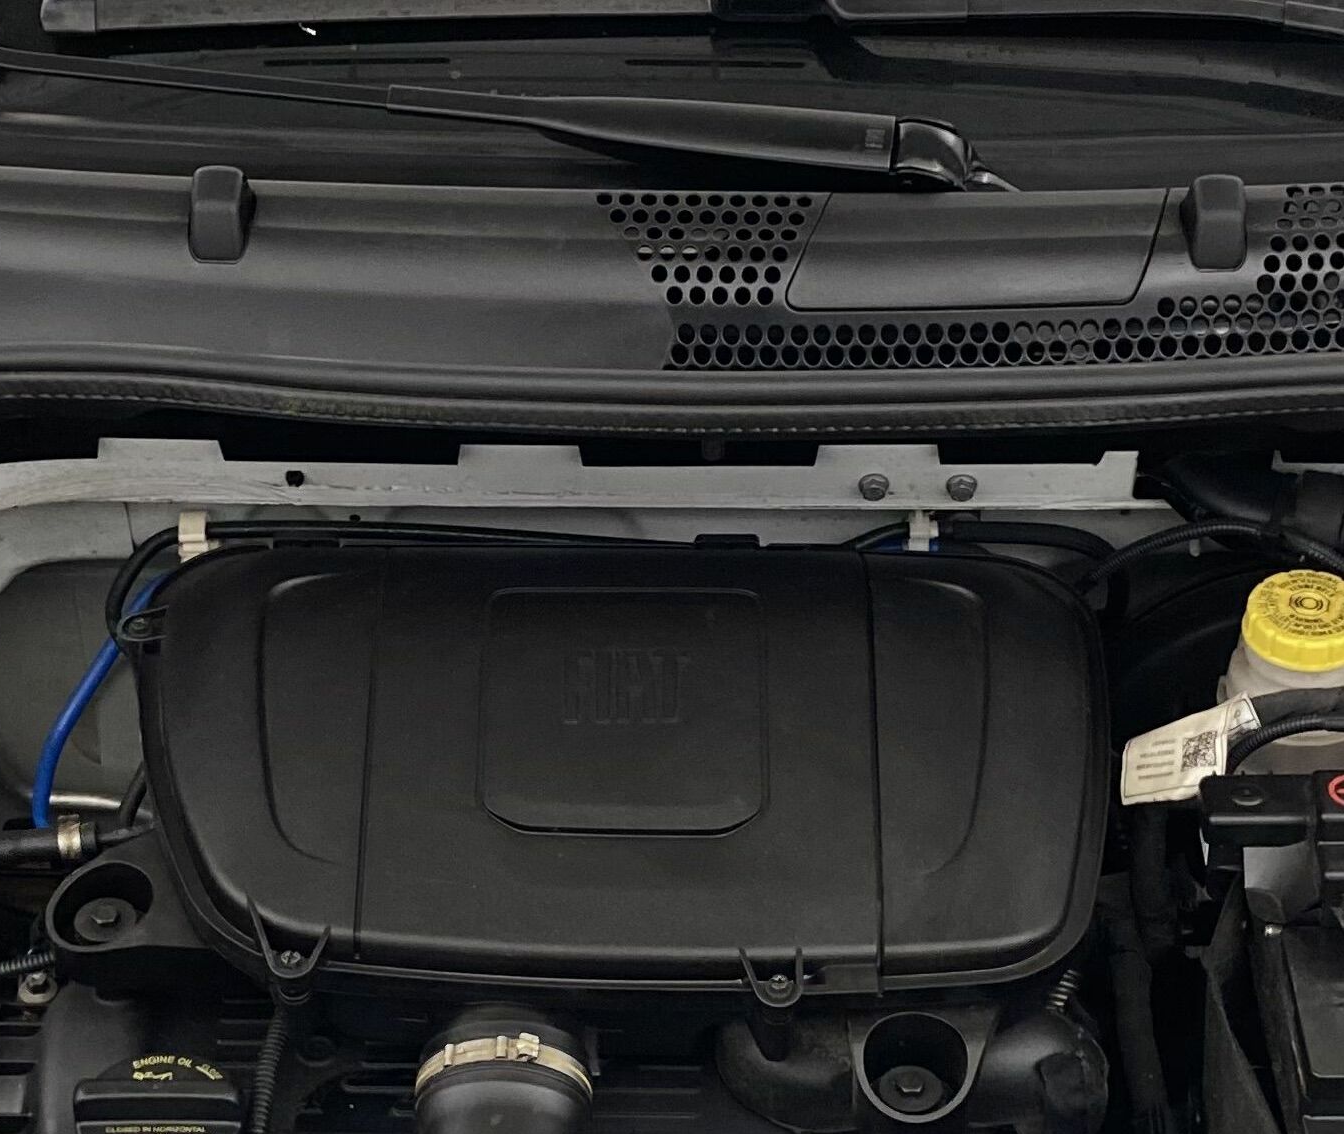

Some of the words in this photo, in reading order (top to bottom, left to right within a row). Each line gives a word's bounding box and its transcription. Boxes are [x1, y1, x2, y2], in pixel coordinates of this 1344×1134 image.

[562, 647, 691, 724] FIAT
[132, 1055, 176, 1069] ENGINE
[177, 1057, 193, 1068] OIL
